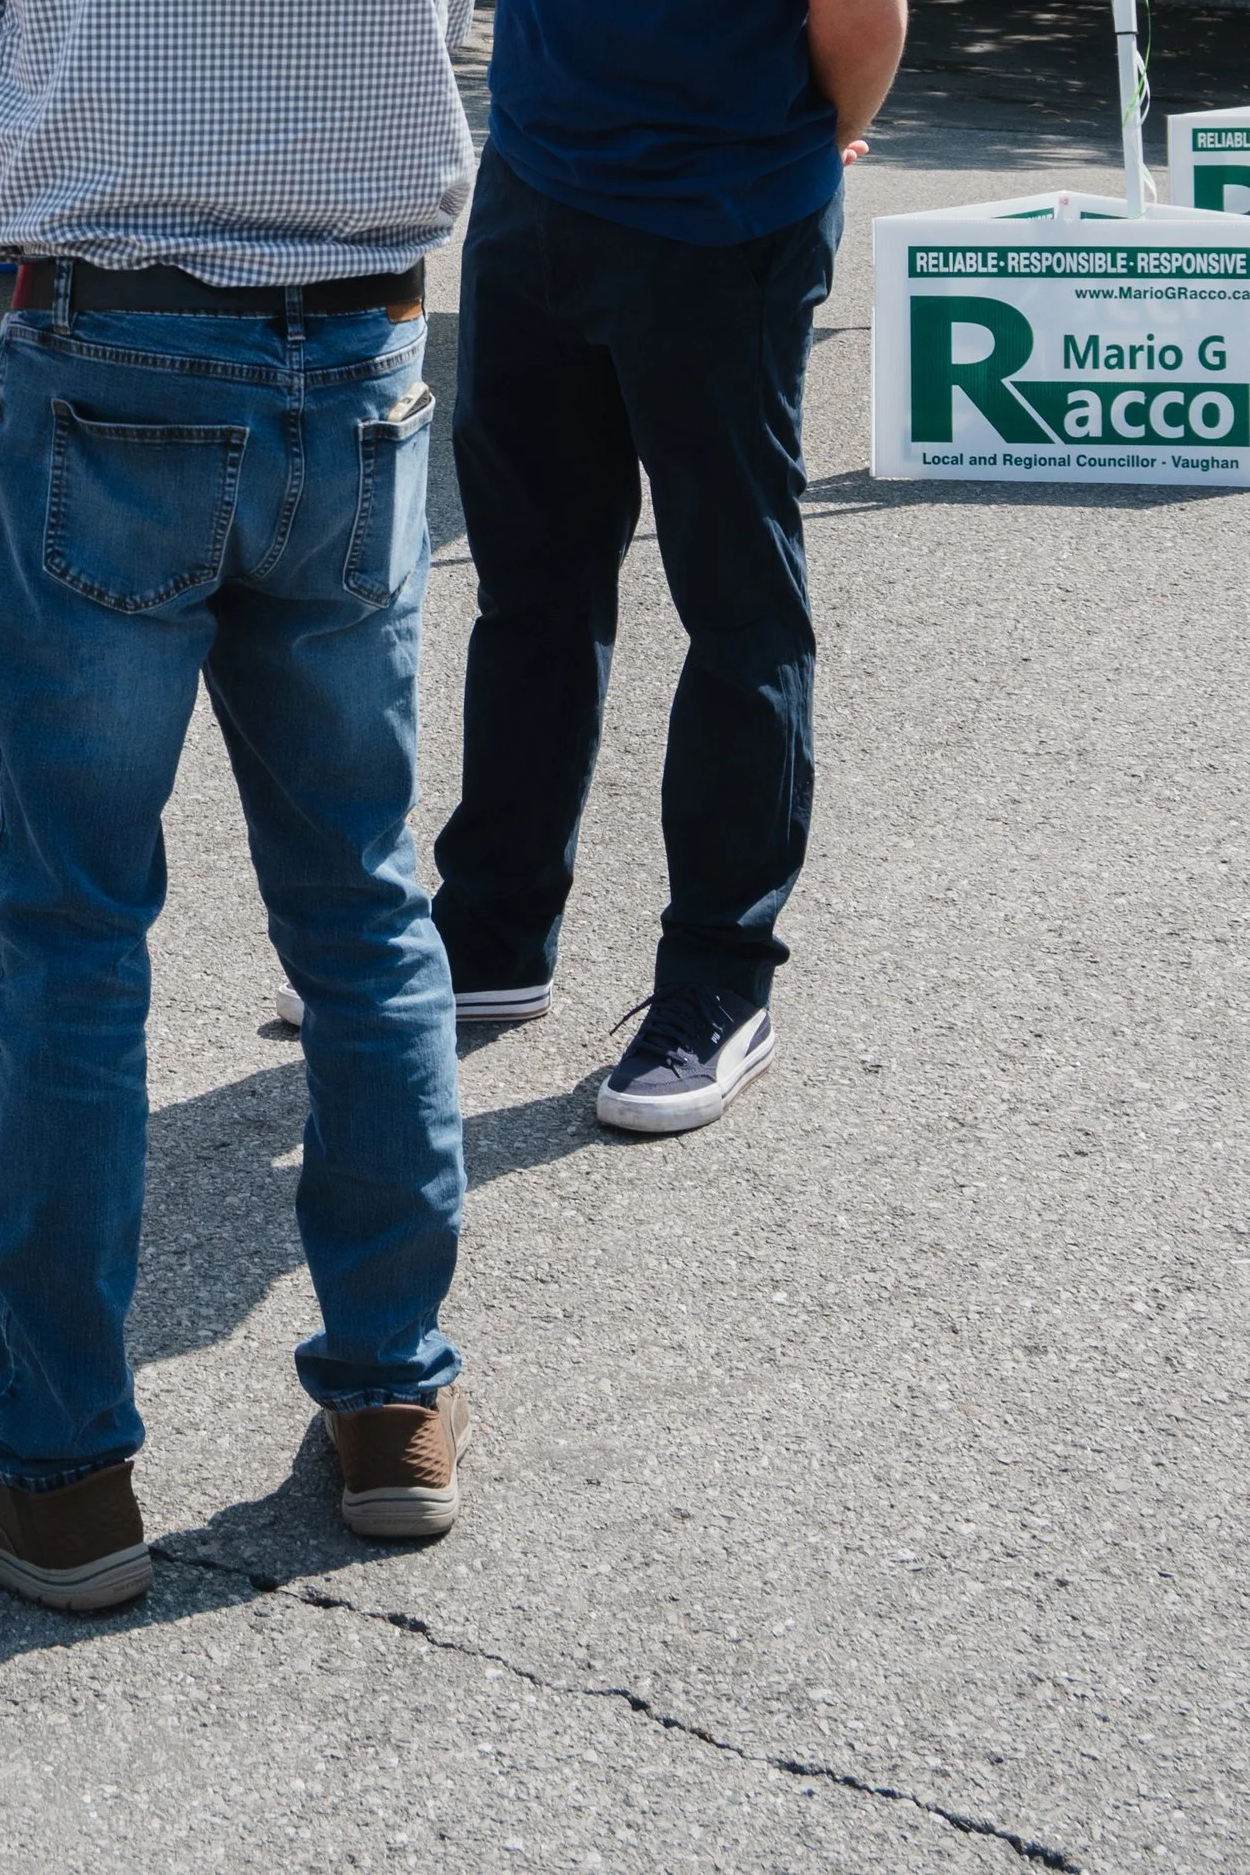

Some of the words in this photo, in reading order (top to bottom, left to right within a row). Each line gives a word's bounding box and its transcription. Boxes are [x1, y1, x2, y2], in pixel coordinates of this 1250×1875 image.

[916, 252, 998, 273] RELIABLE
[1007, 252, 1128, 273] RESPONSIBLE
[1137, 252, 1247, 274] RESPONSIVE
[1075, 286, 1250, 300] www.MarioGRacco.ca
[1063, 333, 1183, 371] Mario
[1198, 335, 1227, 371] G
[923, 452, 963, 466] Local
[969, 453, 997, 466] and
[1003, 454, 1071, 470] Regional
[1076, 454, 1157, 468] Councillor
[1172, 455, 1239, 472] Vaughan
